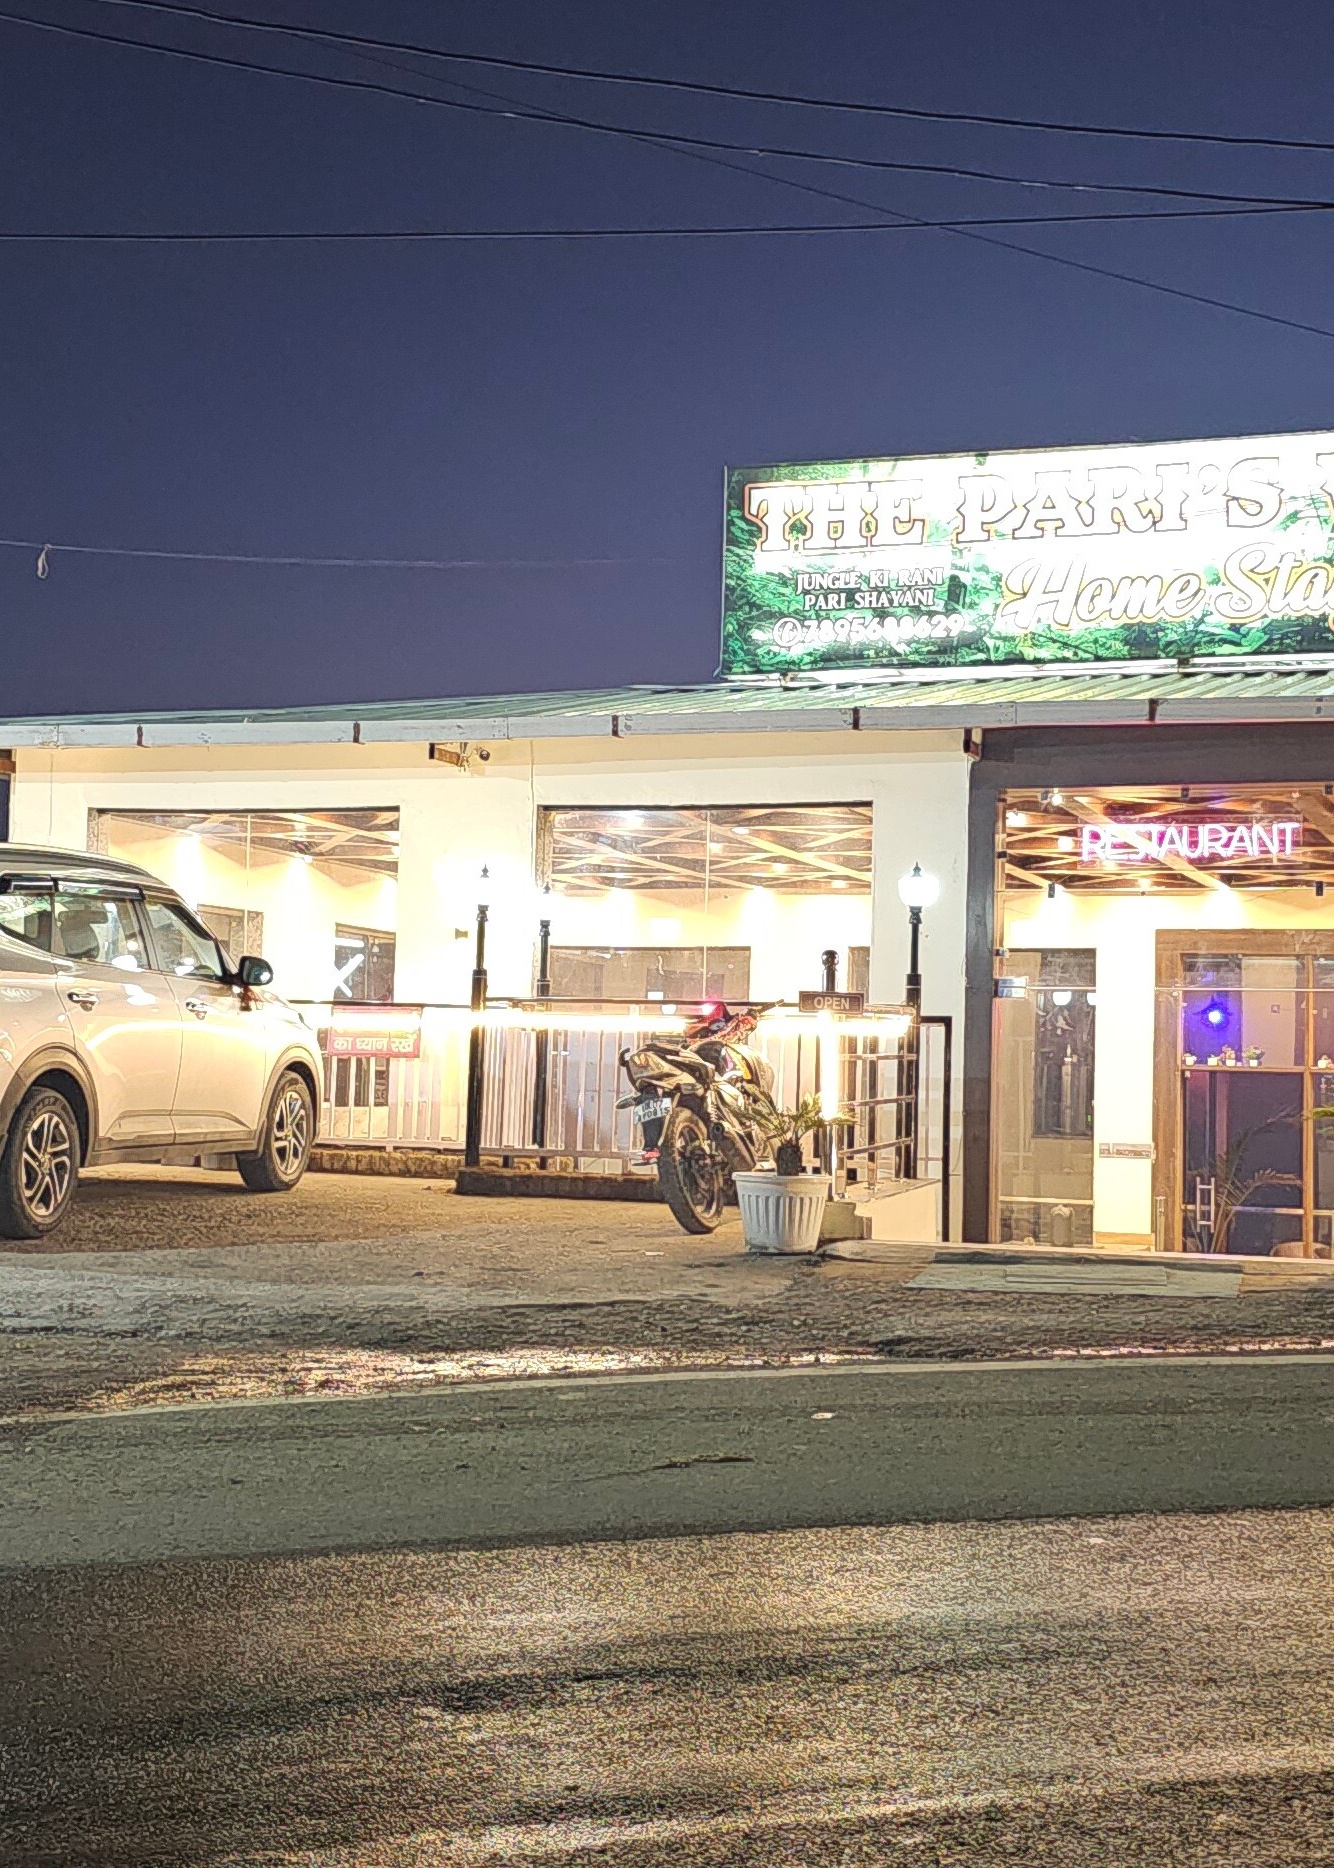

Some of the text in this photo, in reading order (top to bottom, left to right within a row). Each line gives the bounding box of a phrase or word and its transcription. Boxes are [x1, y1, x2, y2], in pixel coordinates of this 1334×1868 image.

[745, 480, 927, 552] THE
[956, 457, 1286, 545] PARI'S
[795, 567, 944, 595] JUNGLE KI RANI
[999, 557, 1207, 630] Home
[803, 588, 936, 611] PARI SHAYANI
[1081, 821, 1301, 862] RESTAURANT
[813, 996, 850, 1010] OPEN
[333, 1037, 353, 1051] का
[355, 1037, 388, 1051] ध्यान
